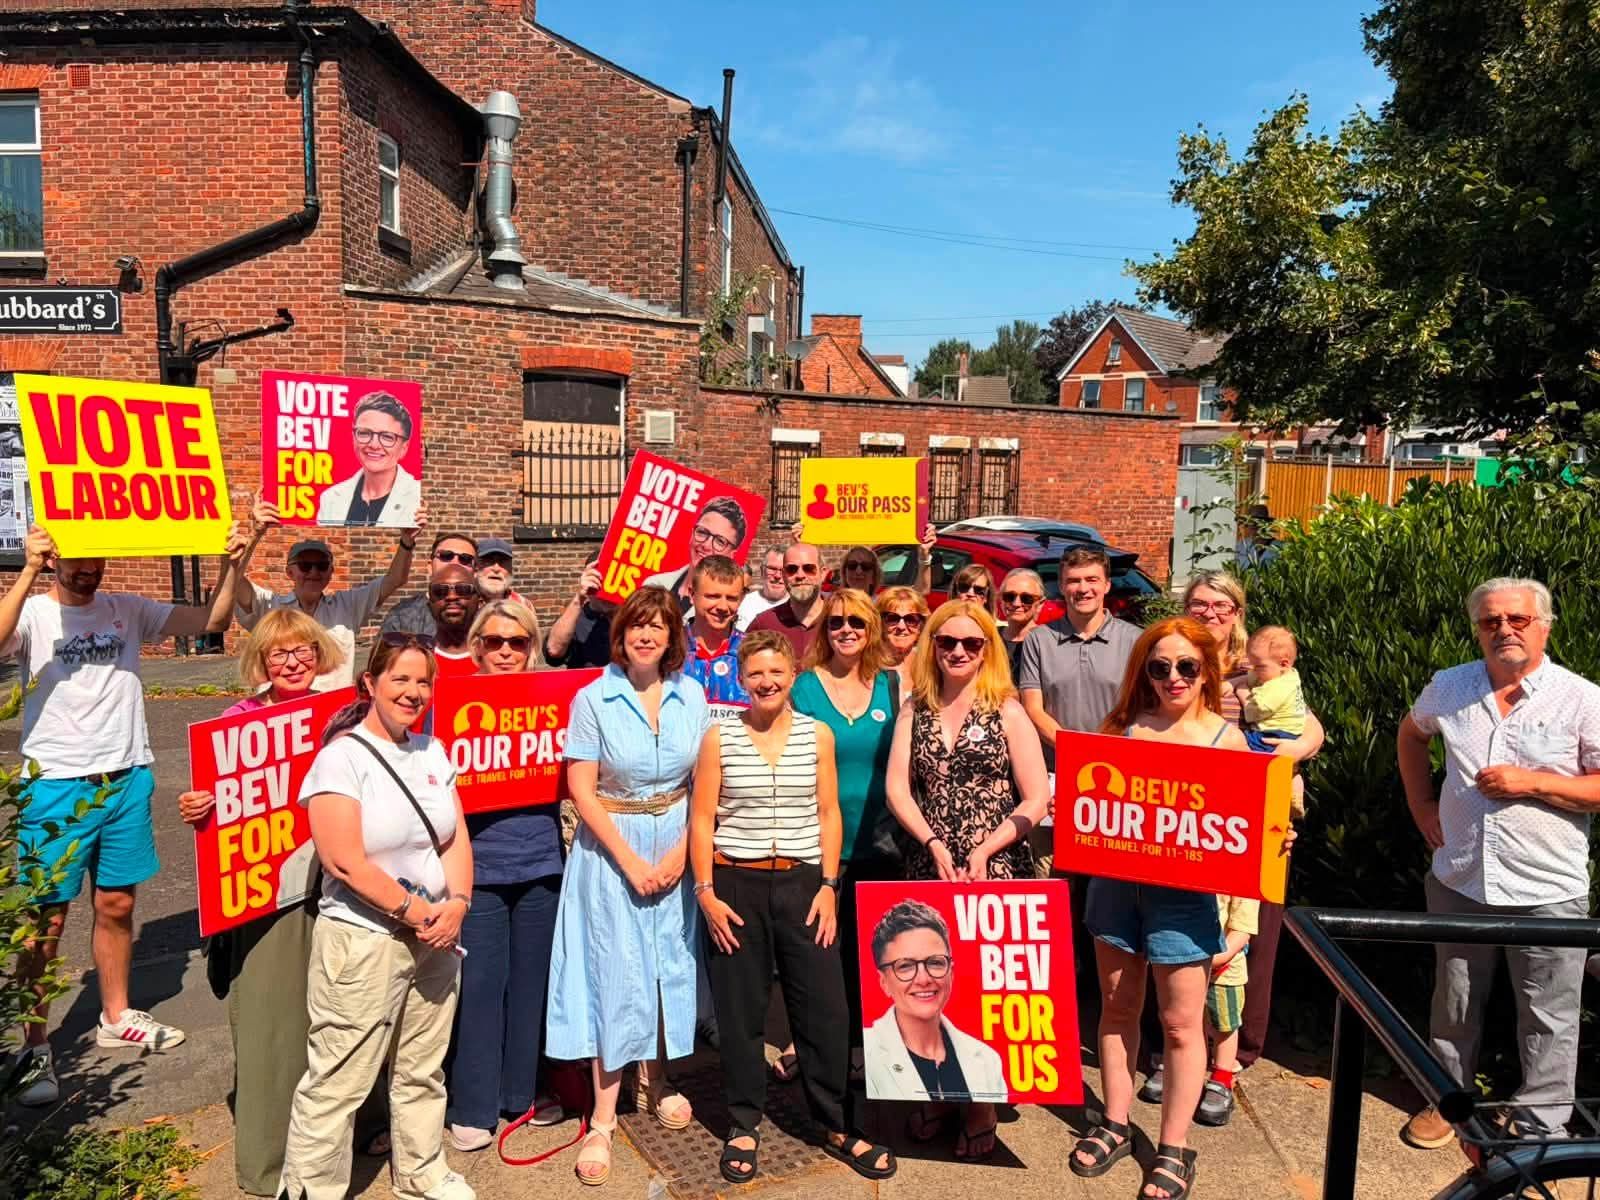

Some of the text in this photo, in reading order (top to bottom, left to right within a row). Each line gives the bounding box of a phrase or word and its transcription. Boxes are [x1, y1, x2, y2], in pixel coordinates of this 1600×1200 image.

[276, 380, 349, 417] VOTE
[28, 391, 210, 469] VOTE
[277, 415, 331, 450] BEV
[277, 450, 333, 485] FOR
[640, 461, 705, 513] VOTE
[837, 483, 869, 496] BEV'S
[40, 471, 221, 521] LABOUR
[278, 485, 316, 519] US
[625, 494, 680, 539] BEV
[837, 496, 911, 513] OUR PASS
[6, 537, 23, 548] KING
[613, 527, 668, 572] FOR
[603, 559, 642, 599] US
[500, 704, 559, 733] BEV'S
[211, 708, 314, 776] VOTE
[451, 734, 512, 775] OUR
[214, 762, 290, 826] BEV
[456, 775, 473, 787] REE
[476, 771, 507, 785] TRAVEL
[510, 768, 526, 780] FOR
[1130, 775, 1206, 810] BEV'S
[217, 809, 297, 873] FOR
[1073, 796, 1249, 855] OUR PASS
[1075, 833, 1099, 847] FREE
[1103, 837, 1139, 853] TRAVEL
[1142, 844, 1162, 857] FOR
[220, 862, 273, 919] US
[953, 893, 1050, 941] VOTE
[979, 943, 1050, 991] BEV
[980, 994, 1056, 1041] FOR
[1007, 1044, 1059, 1093] US
